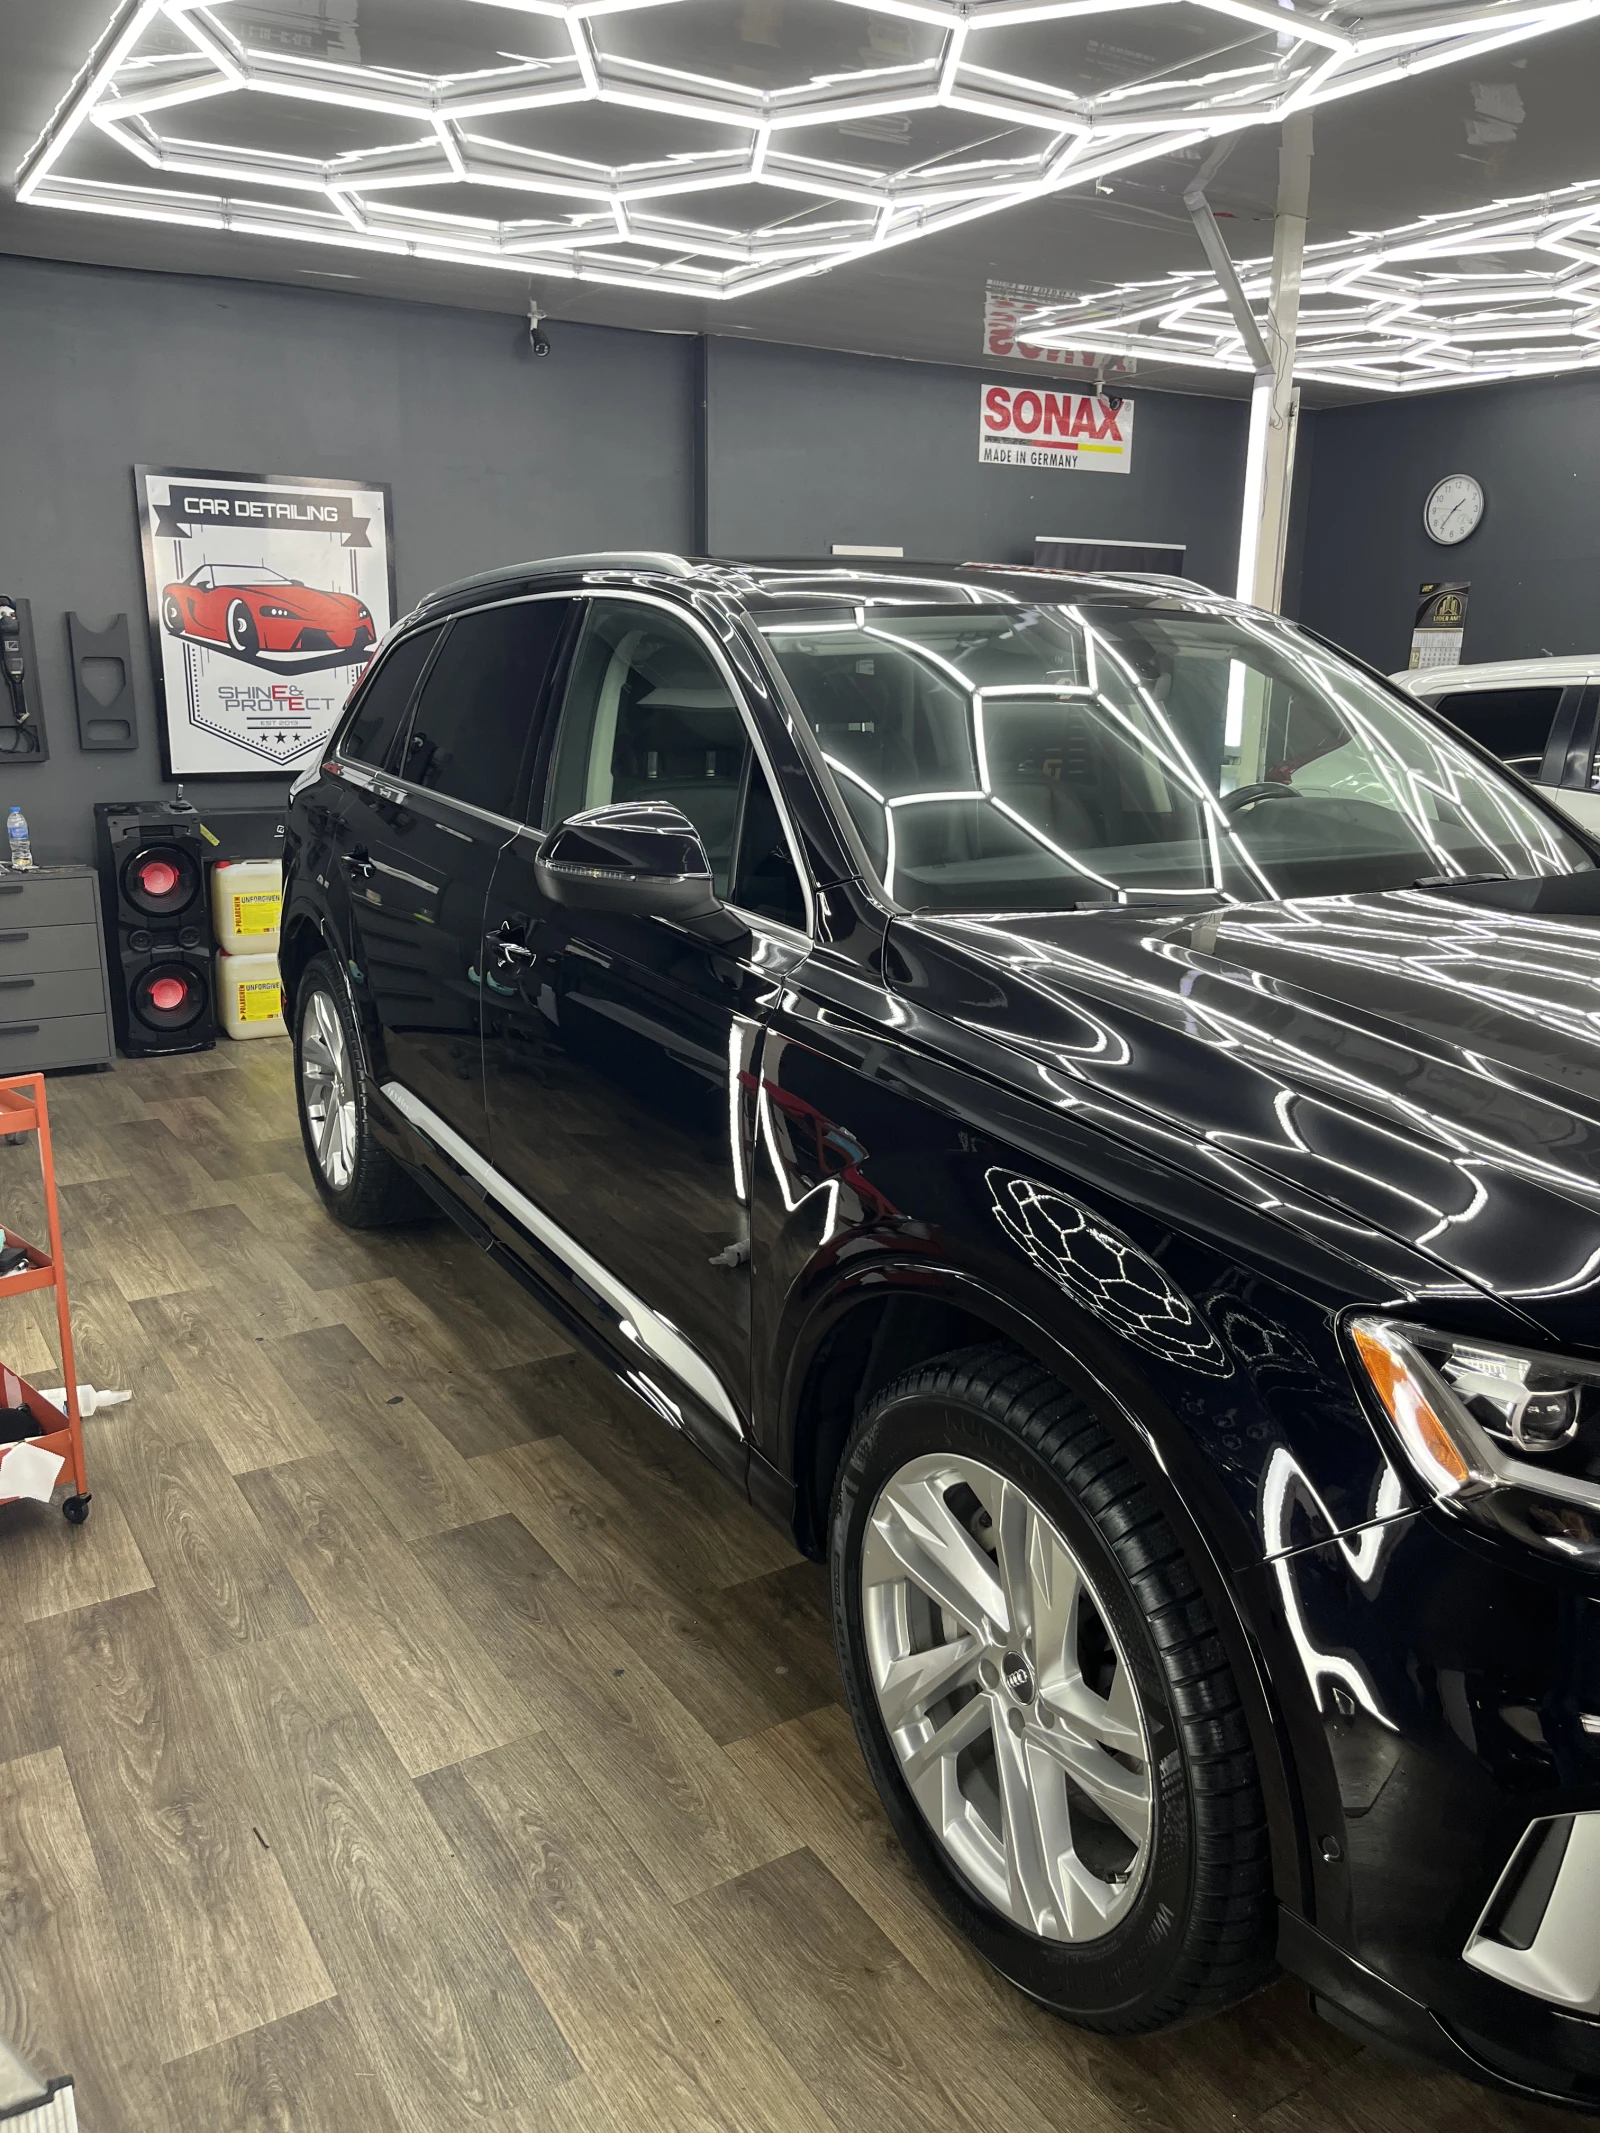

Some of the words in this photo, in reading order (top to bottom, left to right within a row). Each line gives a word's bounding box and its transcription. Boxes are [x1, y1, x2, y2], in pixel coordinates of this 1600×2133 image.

[984, 387, 1124, 441] SONAX
[984, 447, 1012, 463] MADE
[1016, 452, 1027, 465] IN
[1030, 451, 1079, 468] GERMANY
[1455, 481, 1462, 489] 12
[1436, 495, 1444, 503] 10
[1472, 492, 1478, 500] 2
[184, 497, 230, 516] CAR
[234, 500, 338, 522] DETAILING
[1432, 507, 1437, 515] 9
[1473, 505, 1479, 513] 3
[1411, 652, 1420, 663] 12
[225, 698, 335, 712] PROTECT
[241, 894, 280, 904] UNFORGIVEN
